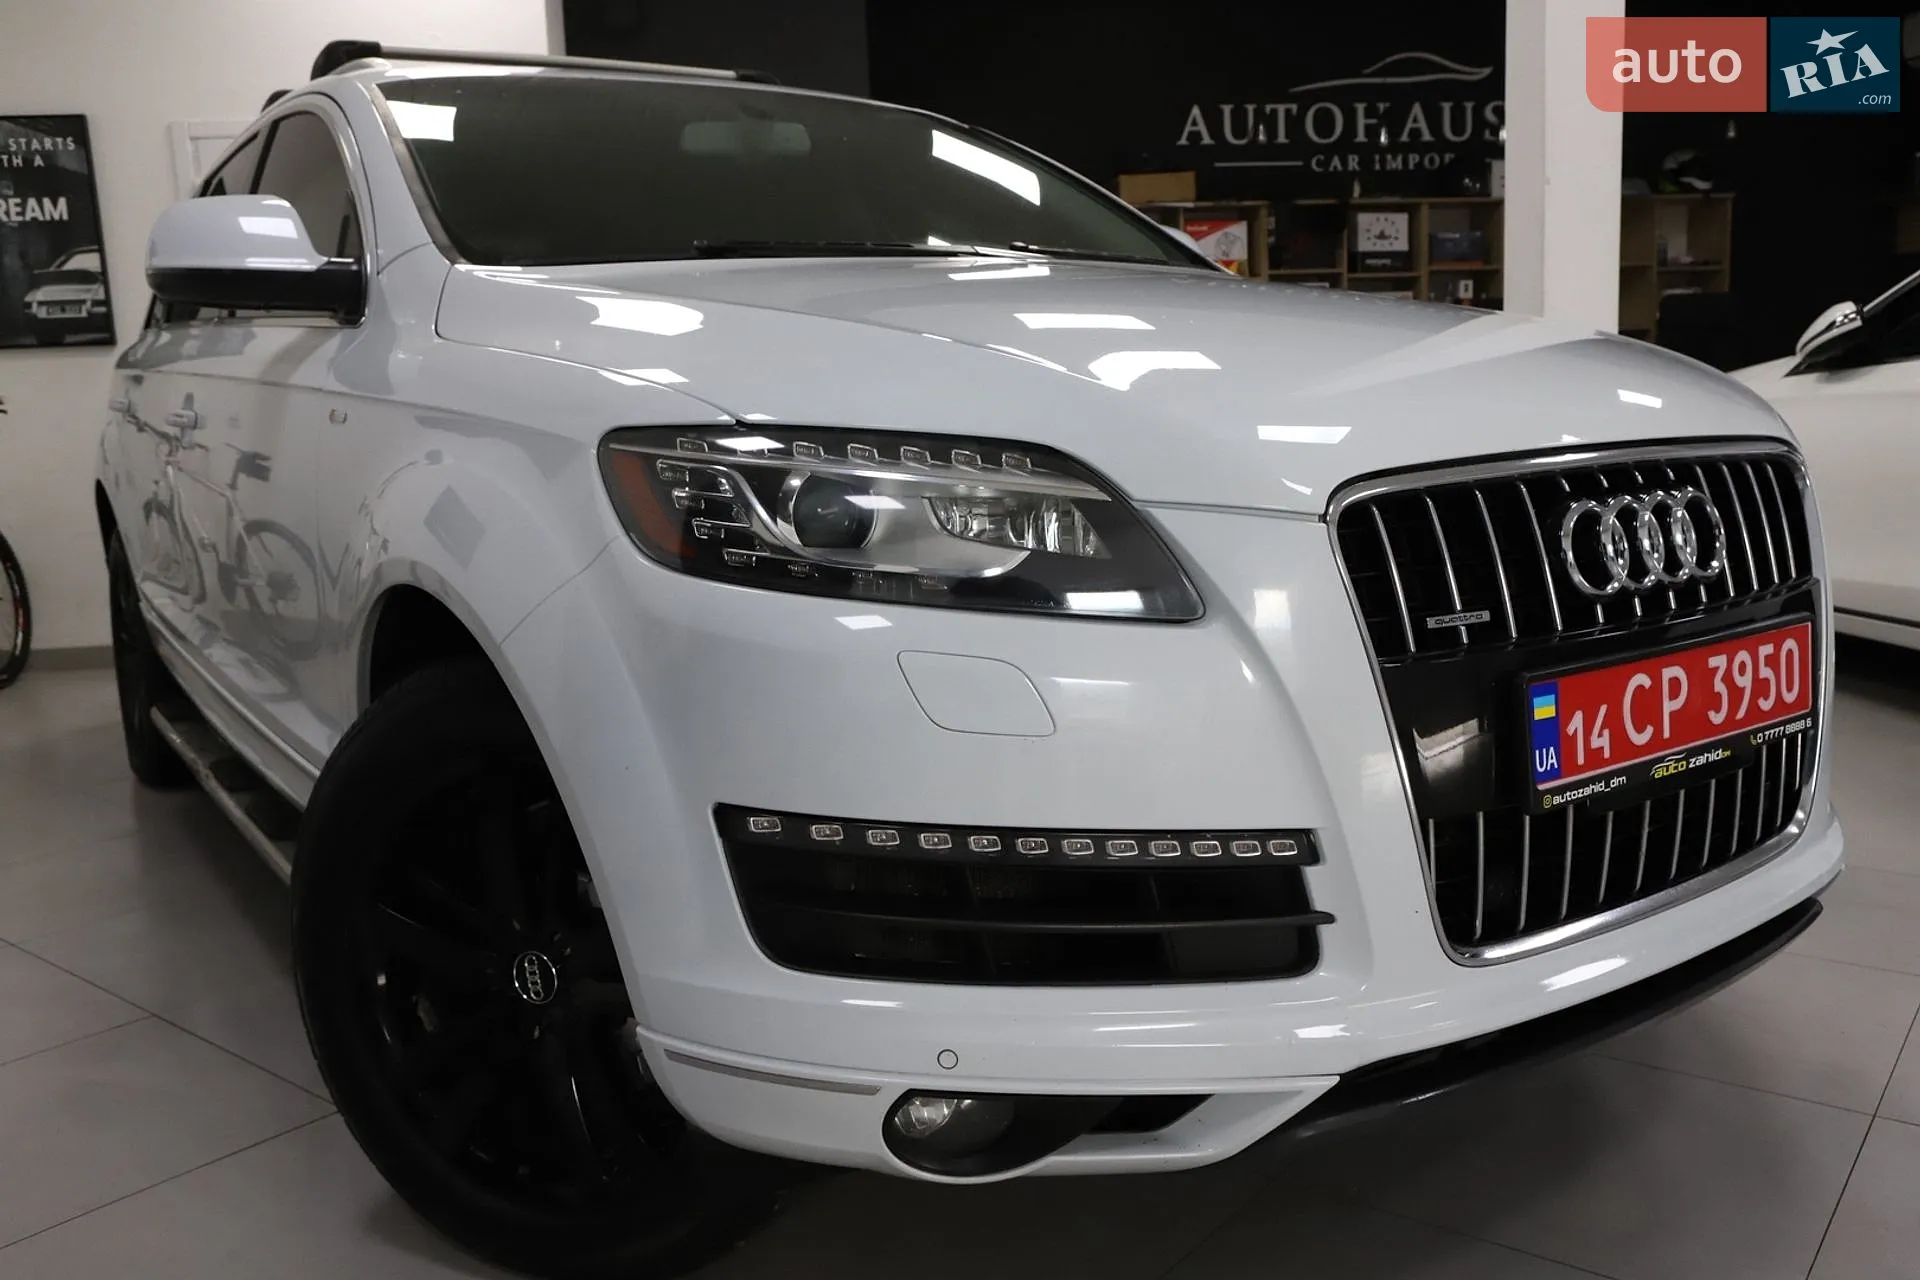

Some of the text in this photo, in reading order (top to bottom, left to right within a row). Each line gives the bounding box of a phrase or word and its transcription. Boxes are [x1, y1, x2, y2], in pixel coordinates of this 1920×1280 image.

[1176, 100, 1505, 145] AUTOHAUS
[8, 136, 76, 151] STARTS
[33, 153, 45, 168] A
[1311, 154, 1360, 172] CAR
[1435, 613, 1483, 625] quattro
[1566, 638, 1800, 766] 14 CP 3950
[1535, 746, 1558, 773] UA
[1654, 760, 1687, 779] auto
